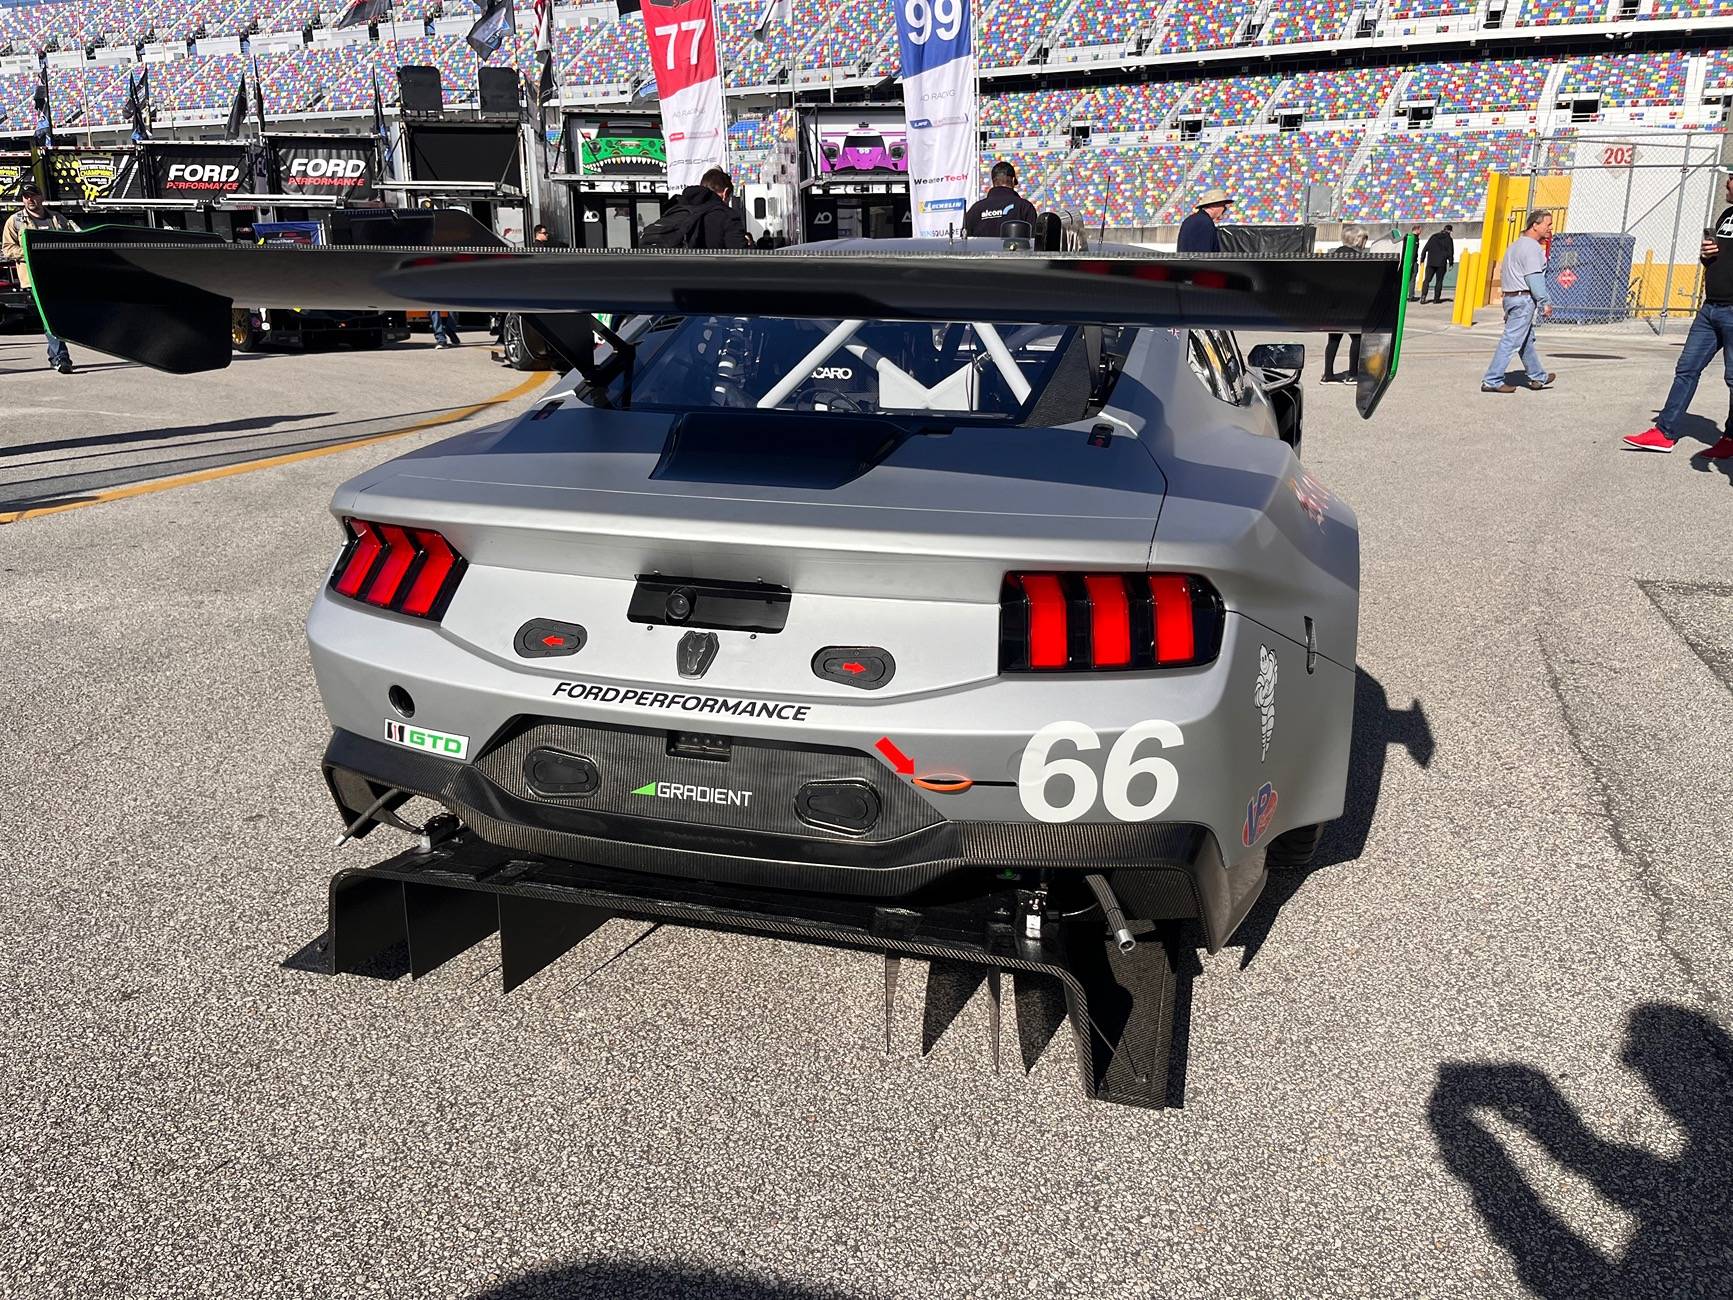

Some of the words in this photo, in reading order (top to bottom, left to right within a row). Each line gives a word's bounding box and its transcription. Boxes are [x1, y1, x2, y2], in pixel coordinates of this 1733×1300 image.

[905, 0, 962, 45] 99
[654, 18, 706, 70] 77
[1603, 147, 1634, 165] 203
[167, 164, 240, 182] FORD
[289, 158, 367, 178] FORD
[287, 177, 365, 186] PERFORMANCE
[981, 209, 1003, 217] alcon
[811, 367, 853, 380] CARO
[409, 730, 462, 754] GTD
[1018, 719, 1185, 823] 66
[657, 782, 753, 807] GRADIENT
